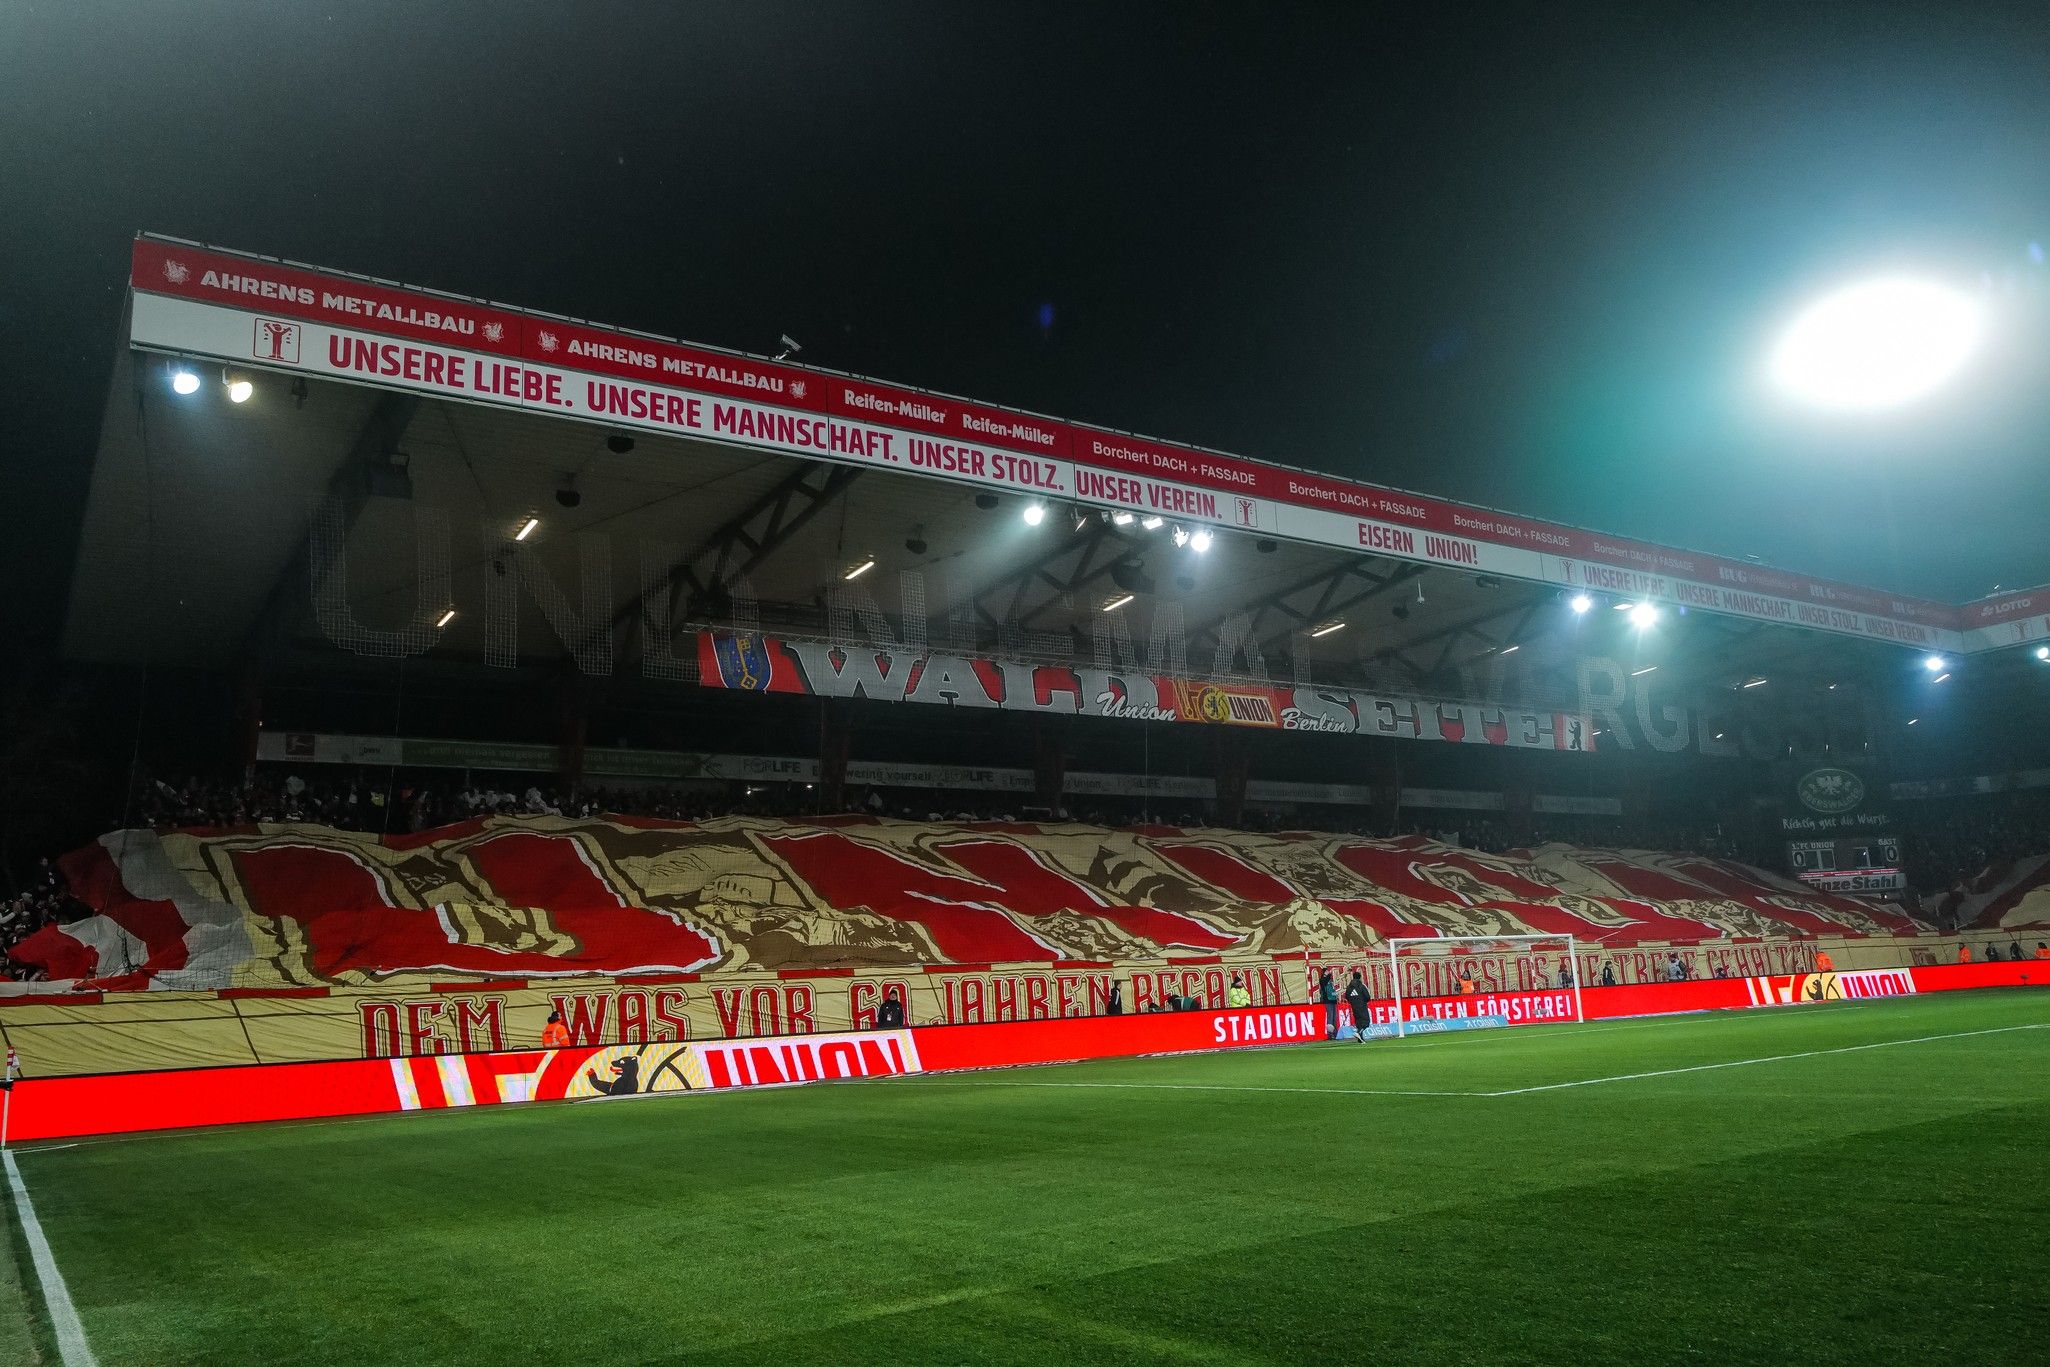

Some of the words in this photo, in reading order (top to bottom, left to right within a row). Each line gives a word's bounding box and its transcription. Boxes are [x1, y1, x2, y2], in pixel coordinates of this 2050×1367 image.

[201, 270, 315, 305] AHRENS
[322, 292, 475, 336] METALLBAU
[567, 338, 657, 369] AHRENS
[662, 359, 784, 393] METALLBAU
[844, 389, 946, 424] Reifen-Müller
[329, 334, 465, 388] UNSERE
[474, 360, 573, 407] LIEBE.
[587, 381, 702, 429] UNSERE
[713, 403, 899, 462] MANNSCHAFT.
[908, 438, 985, 477] UNSER
[991, 453, 1064, 491] STOLZ.
[1076, 470, 1143, 505] UNSER
[1147, 482, 1223, 519] VEREIN.
[962, 414, 1055, 446] Reifen-Müller
[1093, 441, 1149, 464] Borchert
[1153, 454, 1188, 472] DACH
[1191, 465, 1198, 474] +
[1201, 464, 1256, 485] FASSADE
[1289, 481, 1338, 502] Borchert
[1340, 491, 1369, 507] DACH
[1380, 500, 1426, 519] FASSADE
[1358, 522, 1414, 553] EISERN
[1425, 535, 1478, 566] UNION!
[1453, 514, 1495, 533] Borchert
[1496, 523, 1522, 538] DACH
[1531, 529, 1571, 547] FASSADE
[1583, 565, 1633, 592] UNSERE
[1676, 582, 1720, 608] UNSERE
[1095, 691, 1177, 723] Union
[1227, 696, 1276, 723] UNION
[1280, 707, 1348, 733] Berlin
[1811, 841, 1835, 849] UNION
[548, 986, 691, 1046] WAS
[709, 982, 818, 1038] VOR
[931, 971, 1114, 1026] JAHREN
[1213, 1010, 1315, 1043] STADION
[1408, 1001, 1469, 1023] ALTEN
[1471, 1015, 1500, 1029] raisin
[1417, 1020, 1449, 1034] raisin
